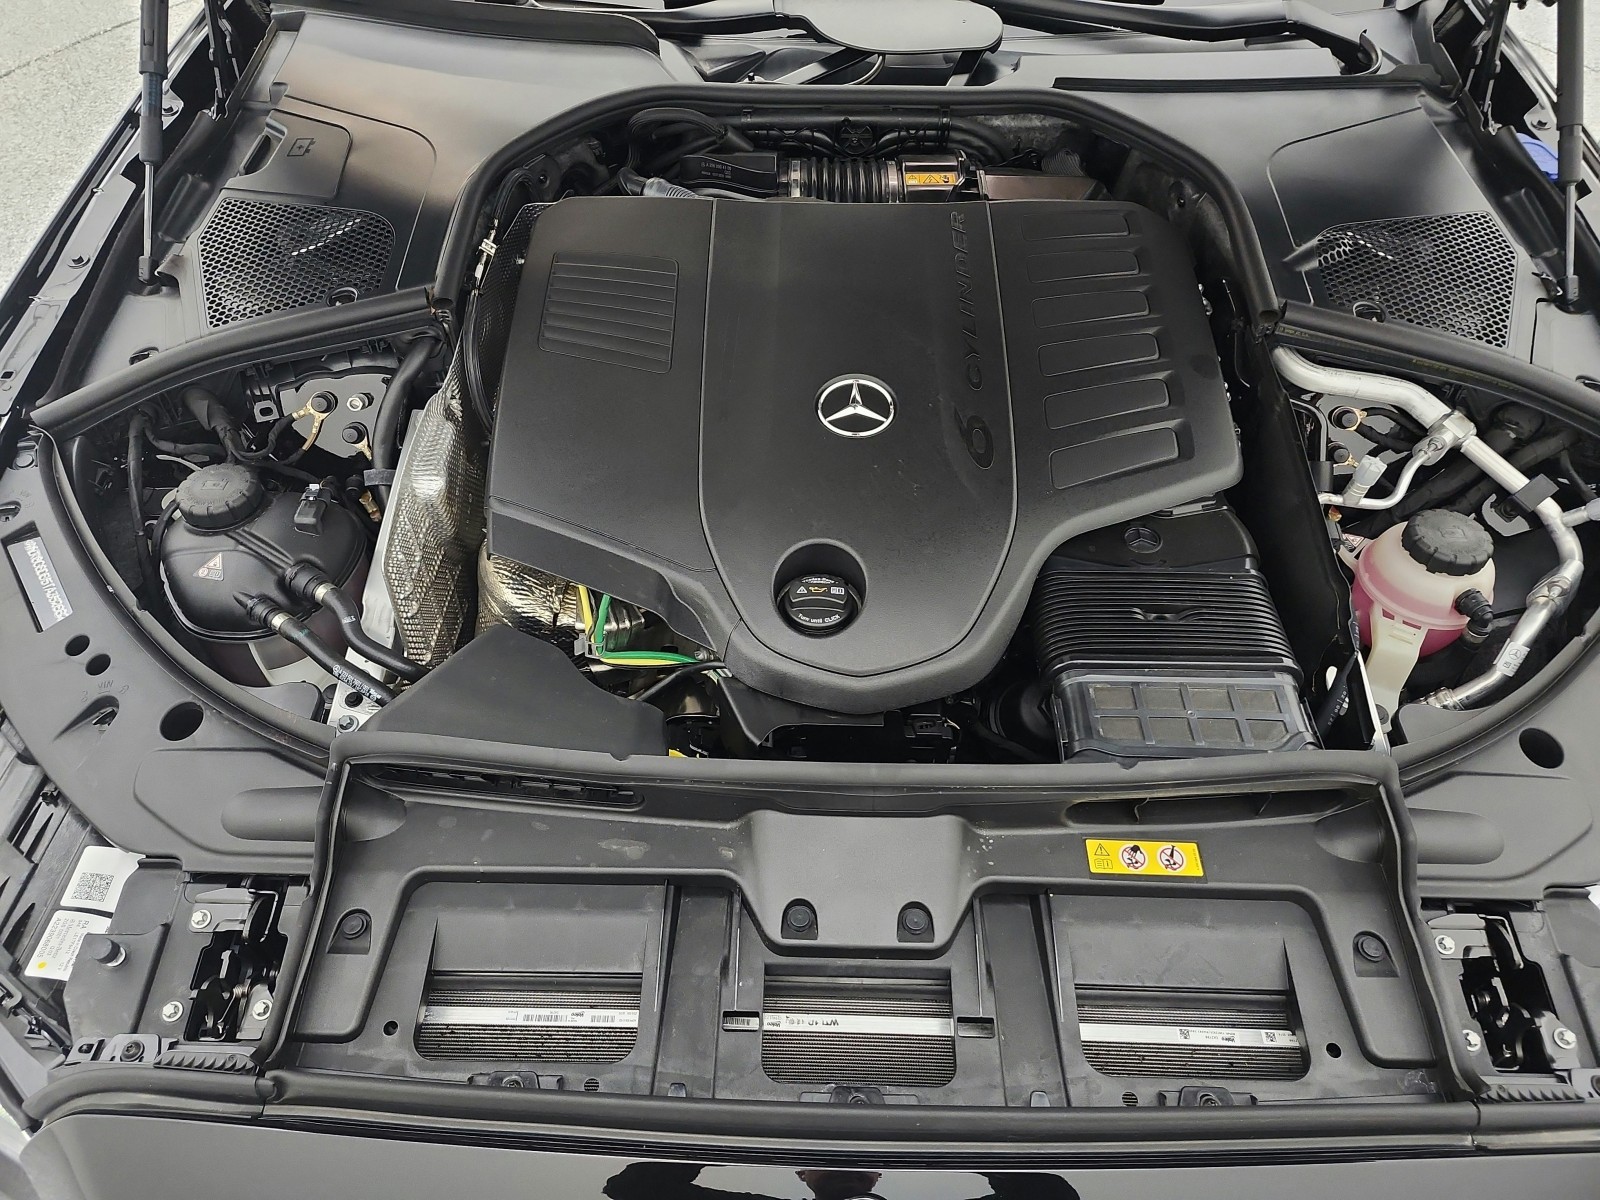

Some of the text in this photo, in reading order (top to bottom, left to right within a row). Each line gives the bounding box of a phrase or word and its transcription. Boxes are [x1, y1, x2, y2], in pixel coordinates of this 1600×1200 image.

[950, 211, 983, 391] CYLINDER
[798, 613, 809, 622] Turn
[825, 614, 840, 622] CLICK
[98, 680, 114, 689] VIN
